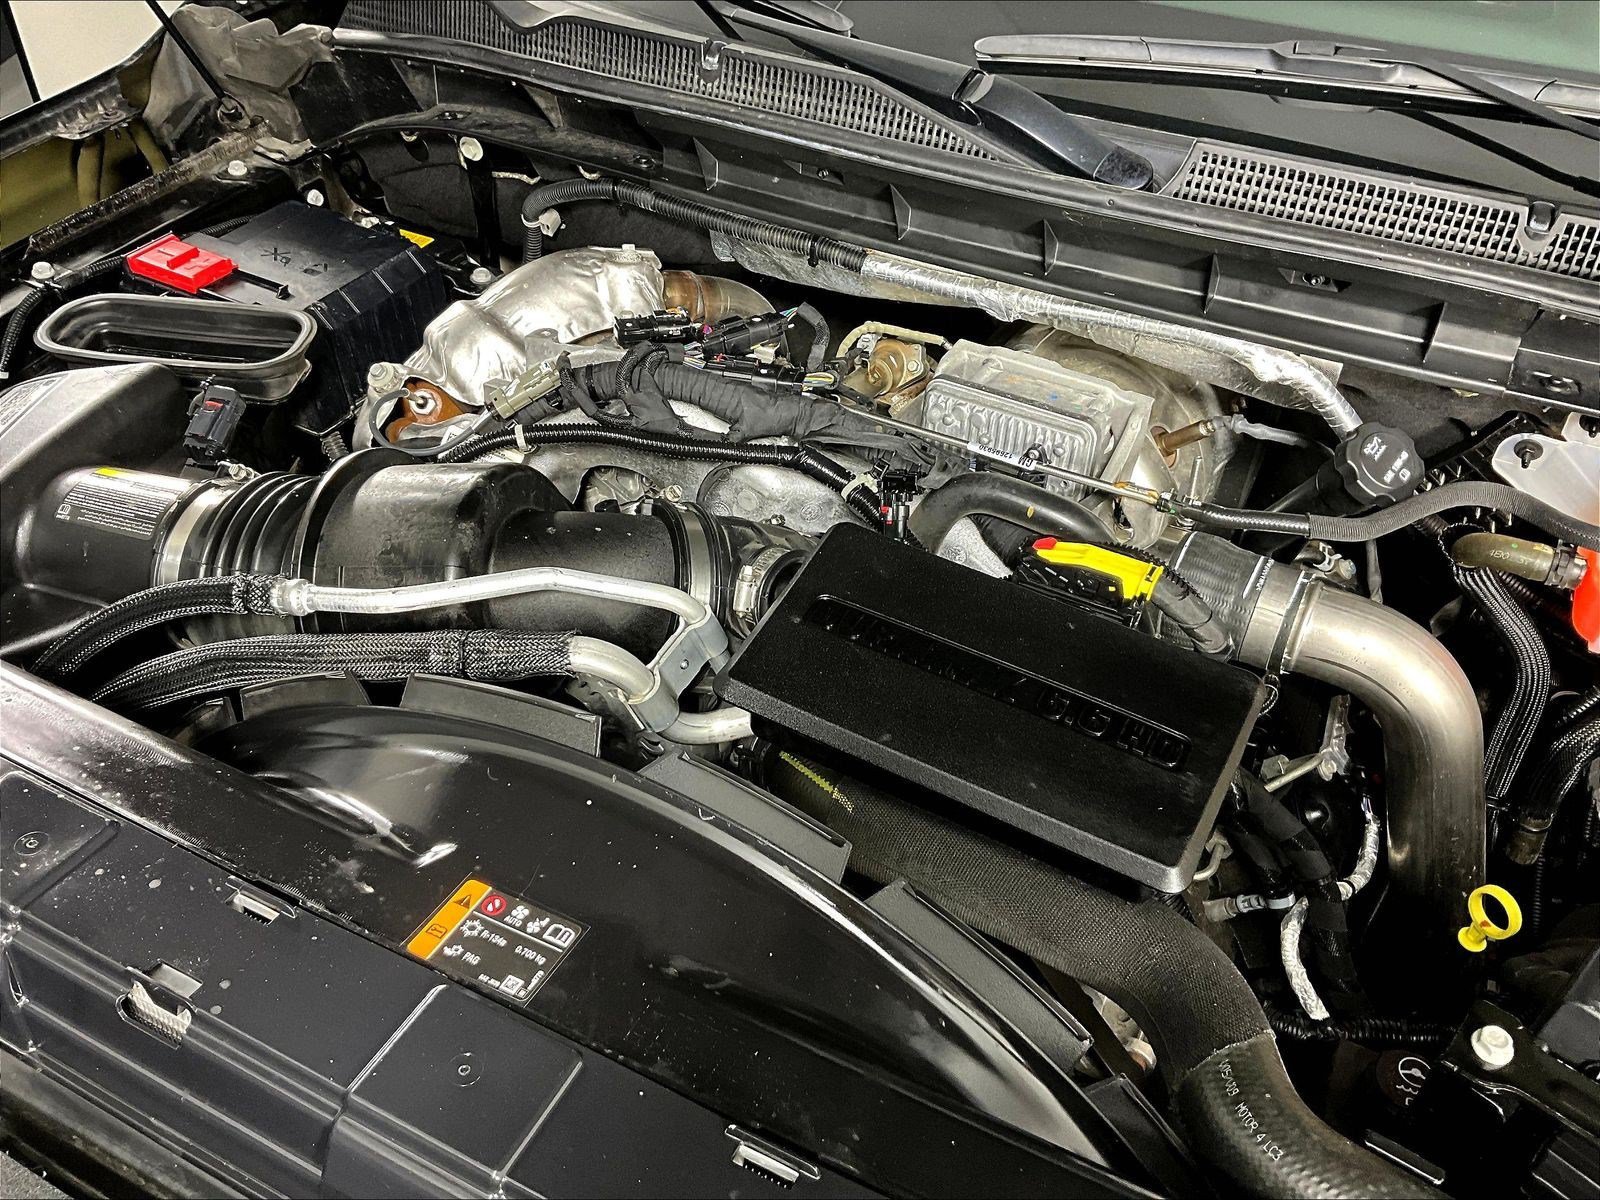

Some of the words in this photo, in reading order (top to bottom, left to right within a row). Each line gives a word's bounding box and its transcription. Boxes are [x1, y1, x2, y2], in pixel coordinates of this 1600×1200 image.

[503, 915, 522, 928] AUTO
[461, 951, 482, 967] PAG
[480, 929, 508, 948] R-134a
[533, 955, 547, 966] kg
[1234, 1101, 1259, 1134] MOTOR
[1256, 1133, 1267, 1144] 4
[1262, 1140, 1284, 1161] LC3
